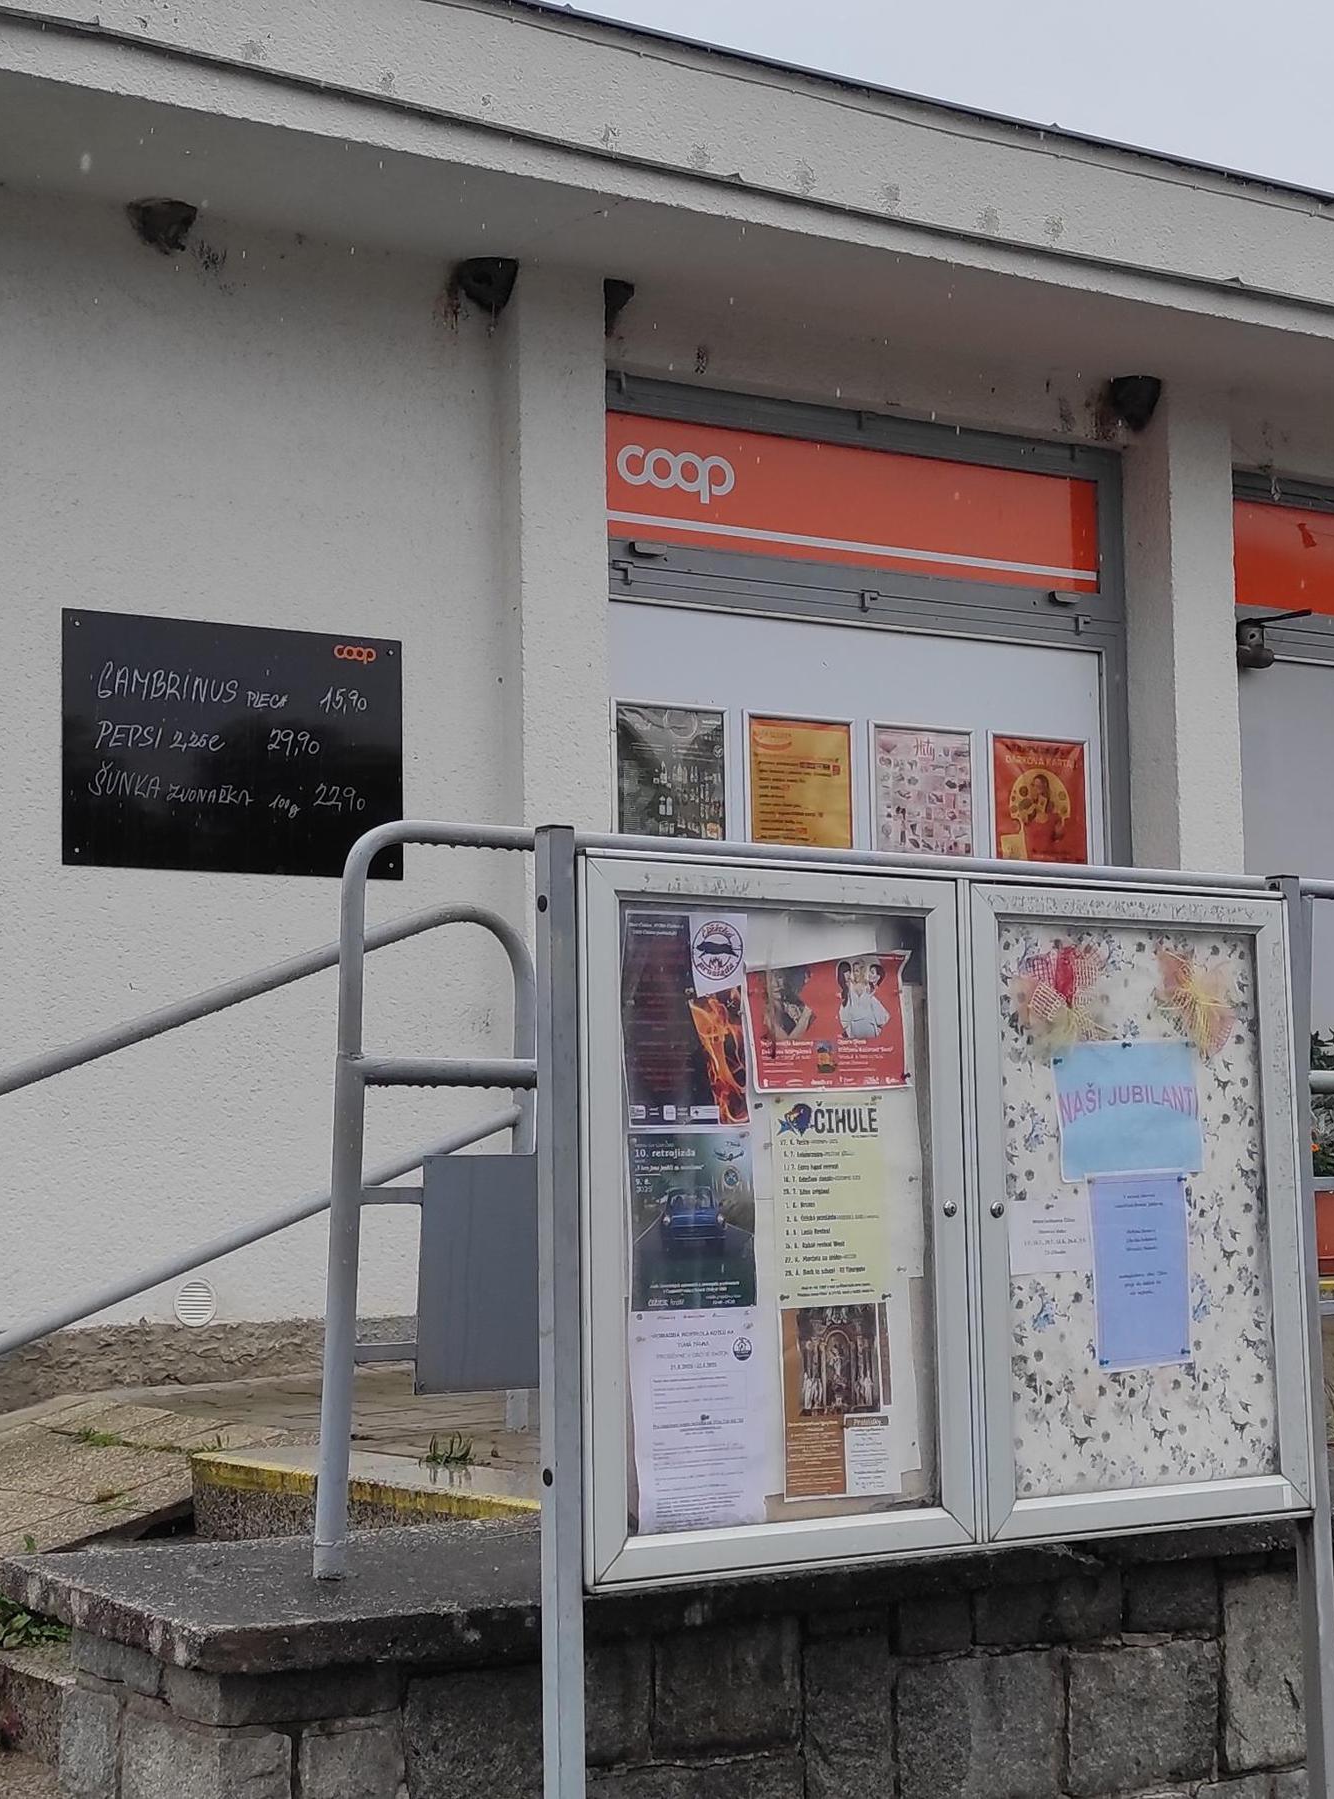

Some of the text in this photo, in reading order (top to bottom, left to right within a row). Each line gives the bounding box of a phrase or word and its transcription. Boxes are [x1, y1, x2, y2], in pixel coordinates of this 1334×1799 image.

[617, 445, 735, 503] coop
[334, 645, 376, 664] coop
[97, 661, 239, 703] GAMBRINUS
[94, 720, 163, 749] PEPSI
[88, 761, 161, 799] ŠUNKA
[1058, 1082, 1200, 1128] NAŠI JUBILANTI
